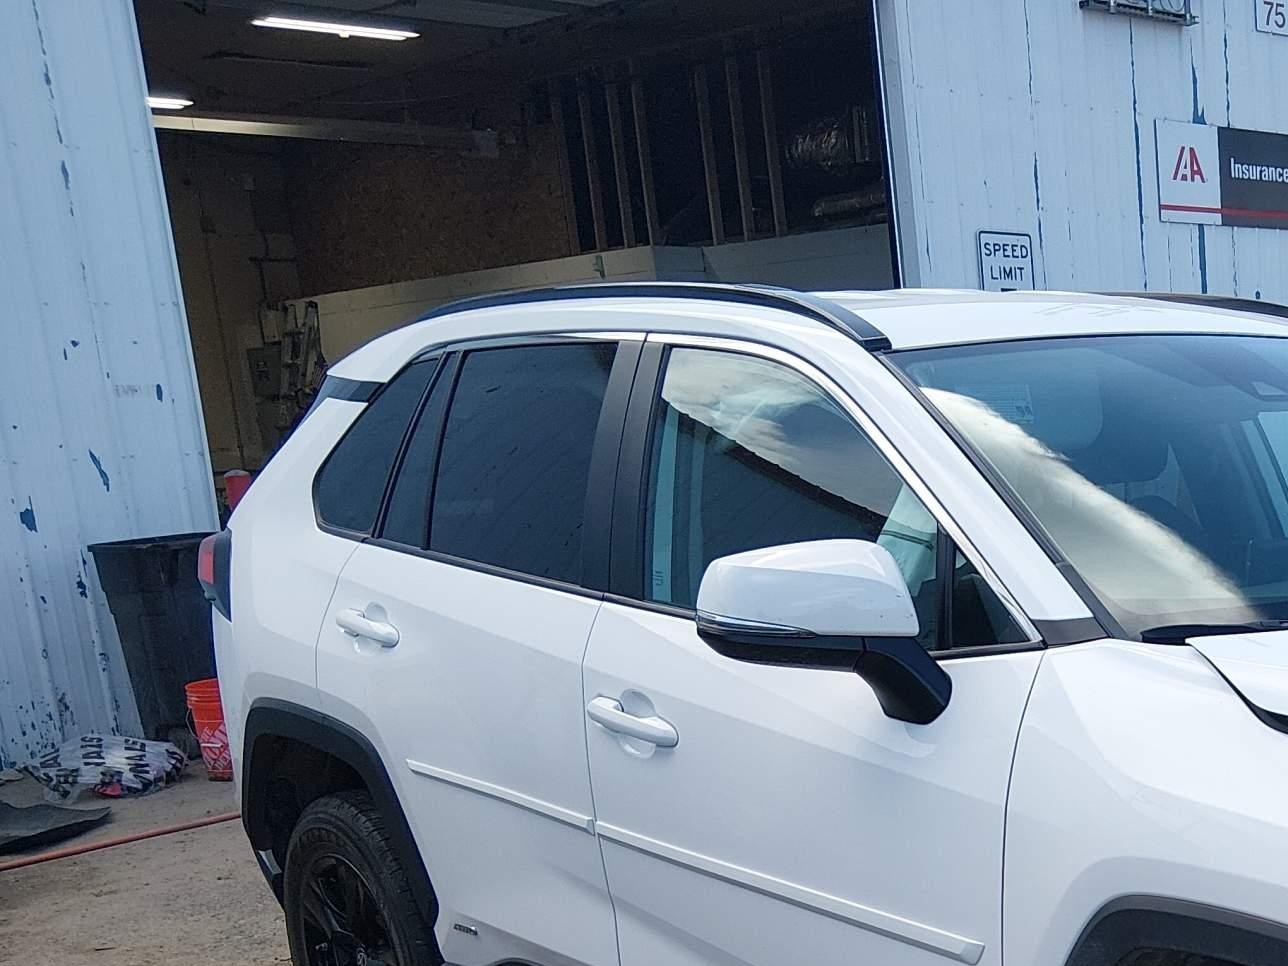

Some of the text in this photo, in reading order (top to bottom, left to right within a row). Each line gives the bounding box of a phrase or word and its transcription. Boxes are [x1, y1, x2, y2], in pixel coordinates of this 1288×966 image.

[1263, 1, 1286, 28] 75
[983, 242, 1029, 259] SPEED
[990, 265, 1025, 281] LIMIT
